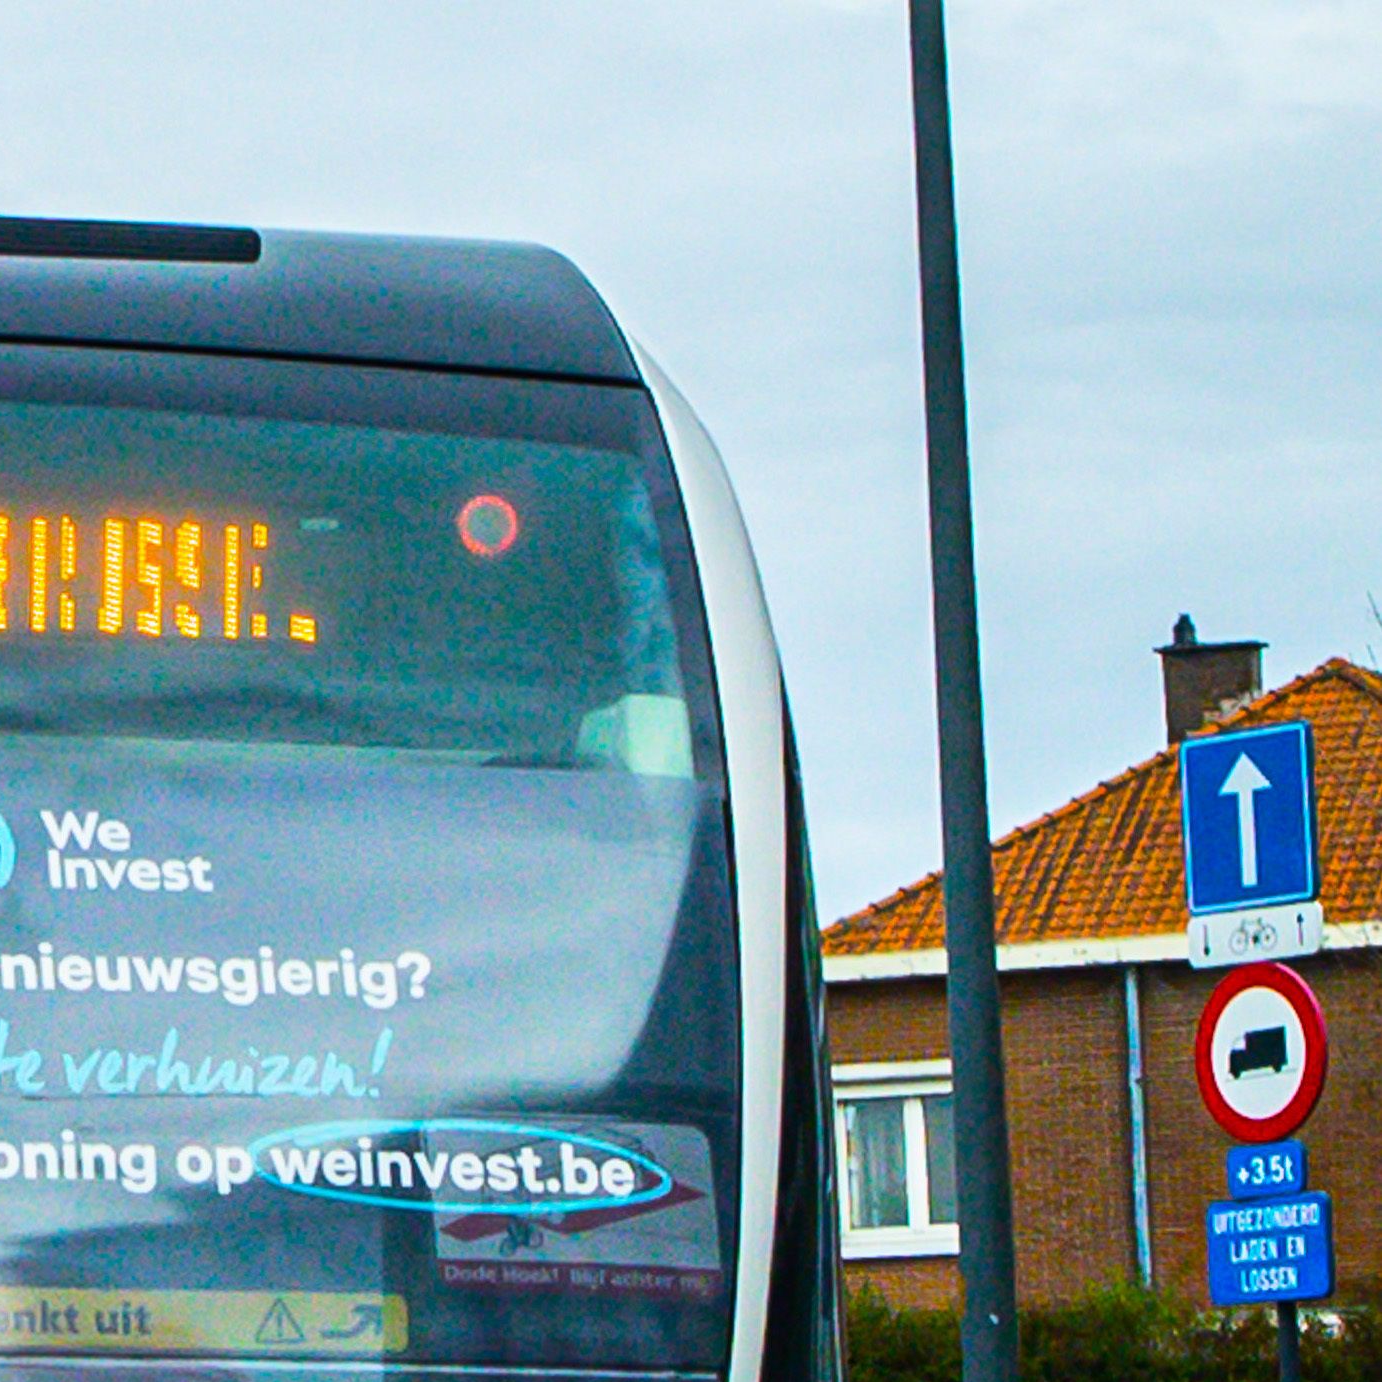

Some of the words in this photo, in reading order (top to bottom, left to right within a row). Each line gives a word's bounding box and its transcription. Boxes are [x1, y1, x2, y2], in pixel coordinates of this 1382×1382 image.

[40, 810, 131, 851] We
[47, 849, 214, 892] Invest
[0, 941, 432, 1010] nieuwsgierig?
[63, 1026, 393, 1098] verhuizen!
[176, 1145, 254, 1195] op
[270, 1136, 636, 1197] weinvest.be
[1213, 1203, 1320, 1235] UITGEZONDERD
[1230, 1236, 1278, 1264] LADEN
[1287, 1234, 1305, 1258] EN
[1241, 1266, 1299, 1293] LOSSEN
[94, 1302, 153, 1337] uit
